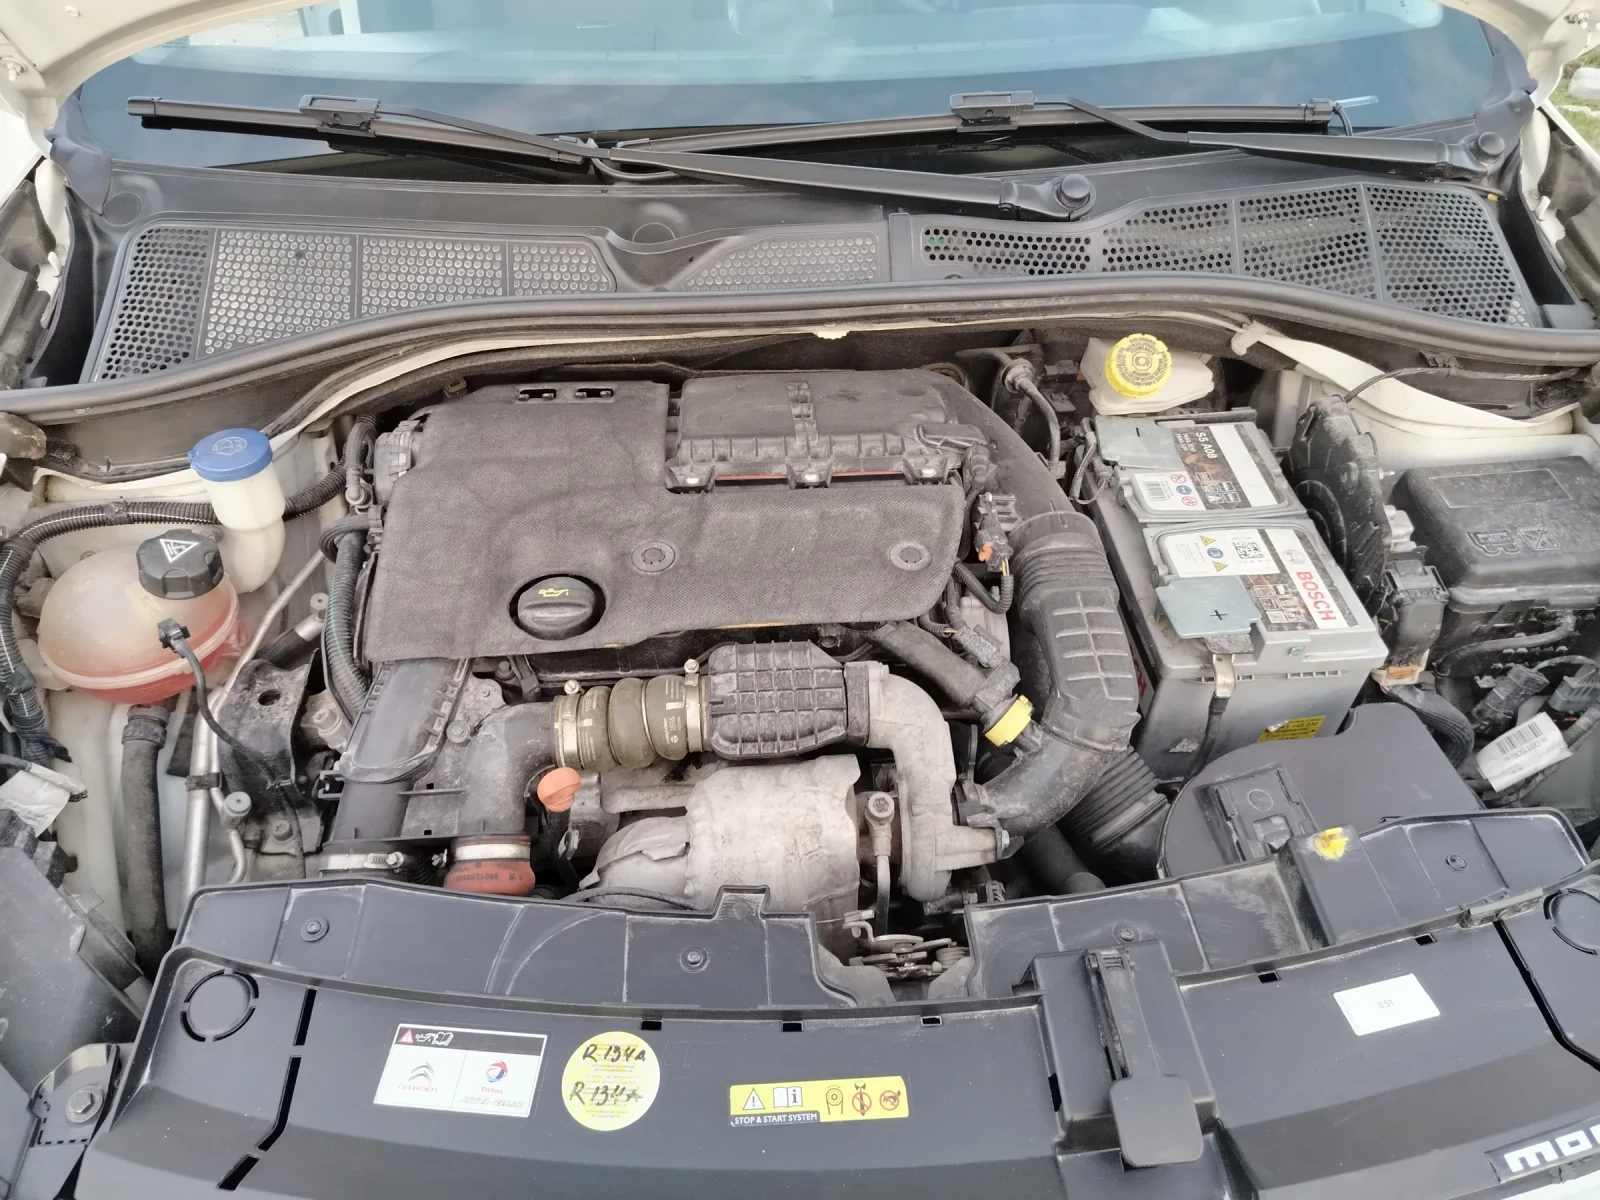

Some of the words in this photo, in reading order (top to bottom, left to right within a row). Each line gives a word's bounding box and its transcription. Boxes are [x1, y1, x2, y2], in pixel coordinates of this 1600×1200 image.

[1195, 432, 1209, 442] S5
[1296, 571, 1337, 620] BOSCH
[481, 1086, 505, 1095] TOTAL
[734, 1116, 756, 1125] STOP
[756, 1116, 762, 1124] &
[763, 1115, 787, 1124] START
[788, 1112, 818, 1122] SYSTEM
